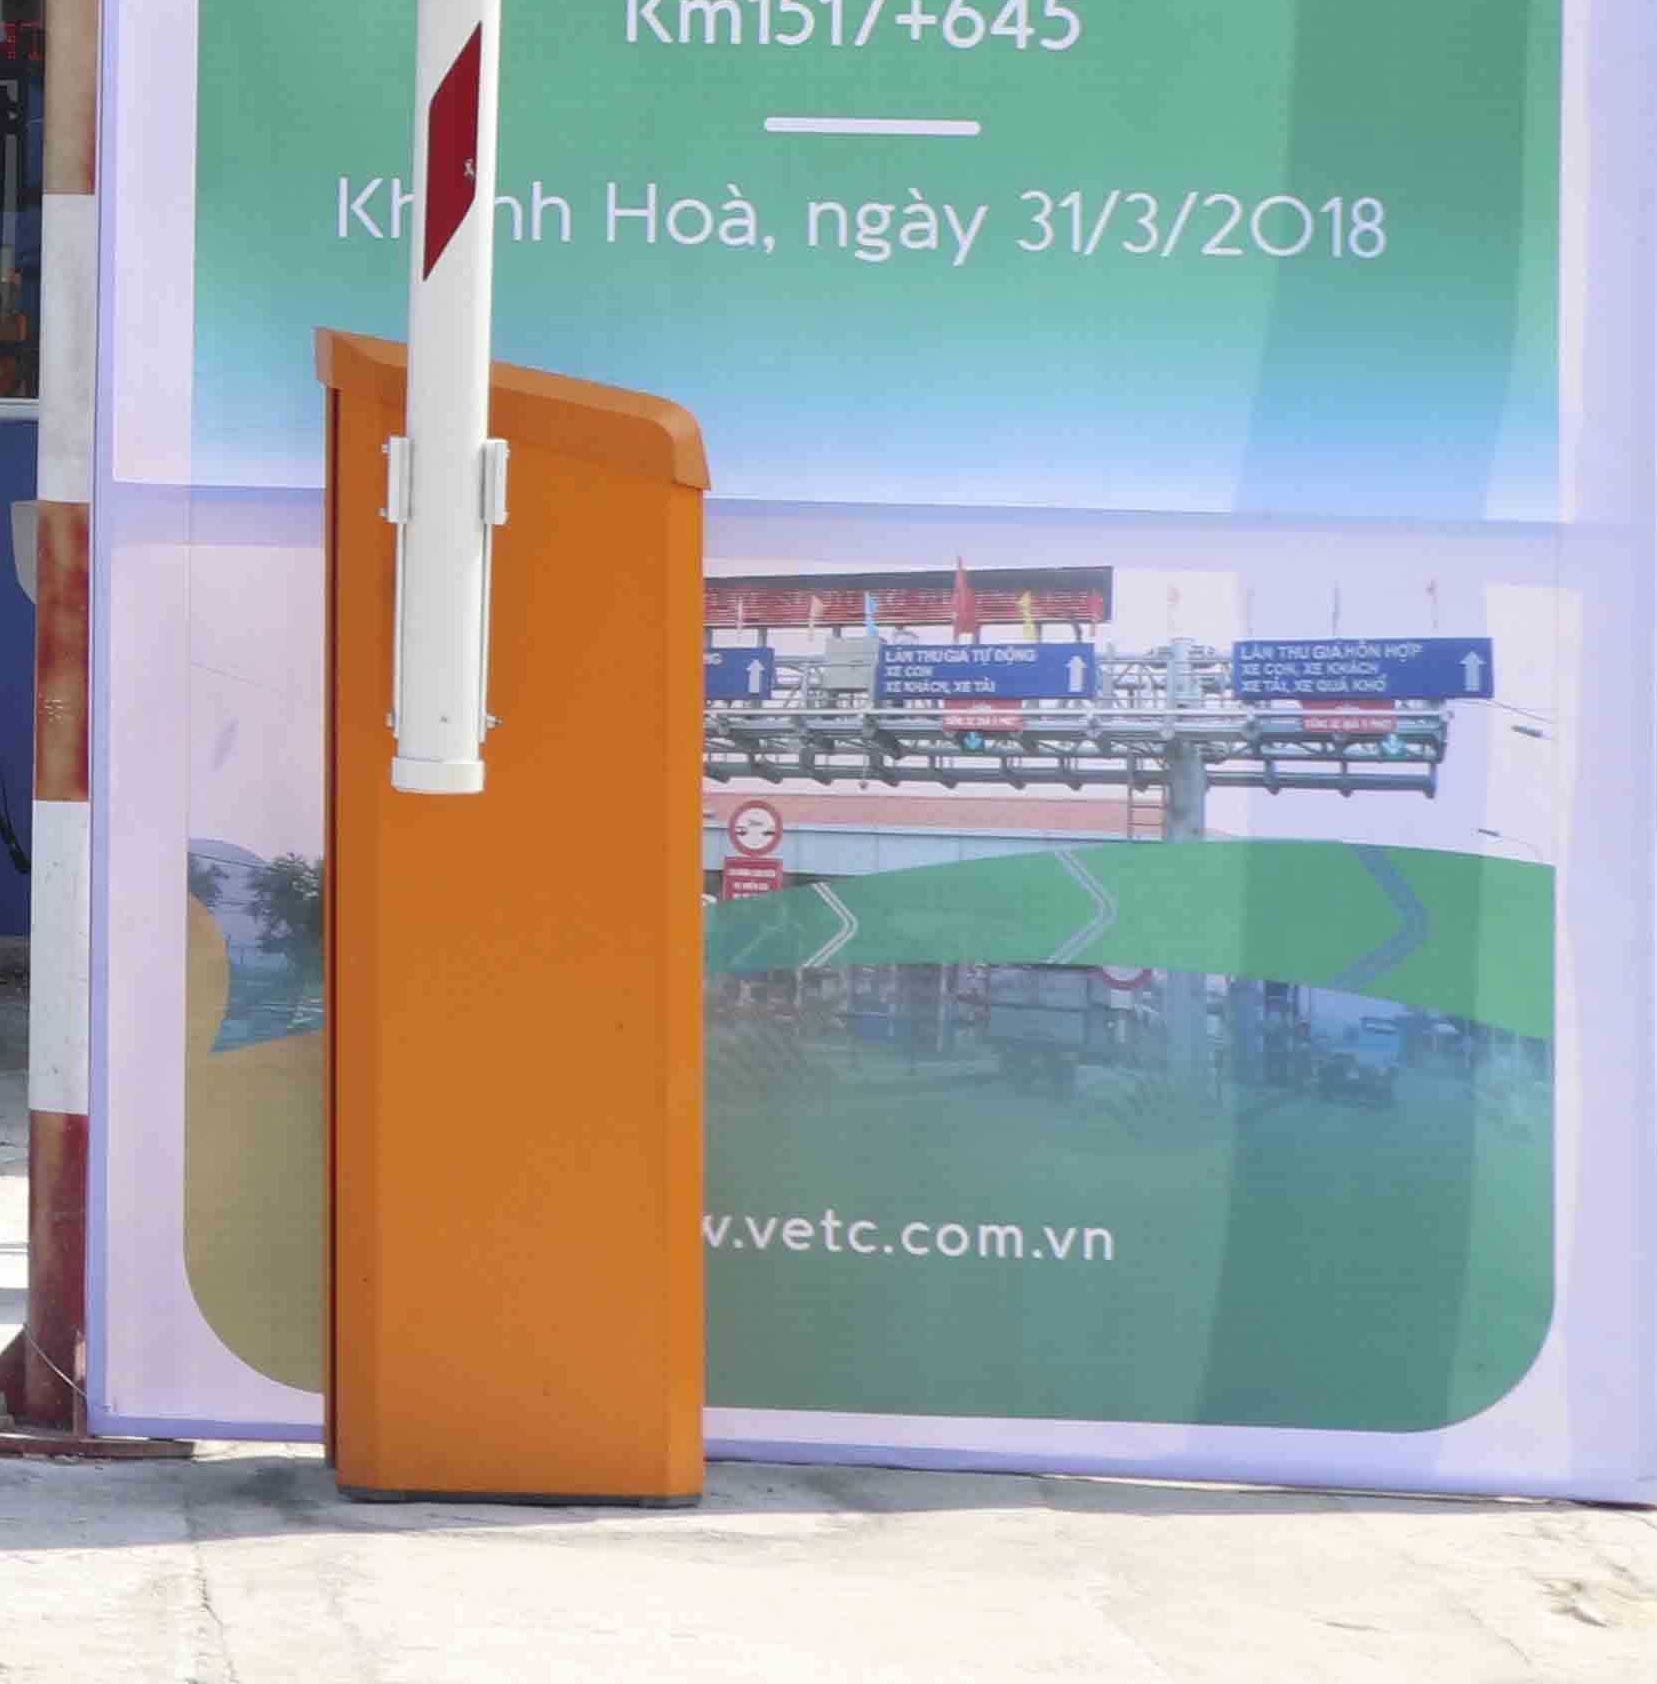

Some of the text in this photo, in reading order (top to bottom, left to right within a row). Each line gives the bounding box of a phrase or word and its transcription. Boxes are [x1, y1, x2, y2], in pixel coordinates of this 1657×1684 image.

[337, 177, 1388, 267] Khnh Hoà, ngày 31/3/2018
